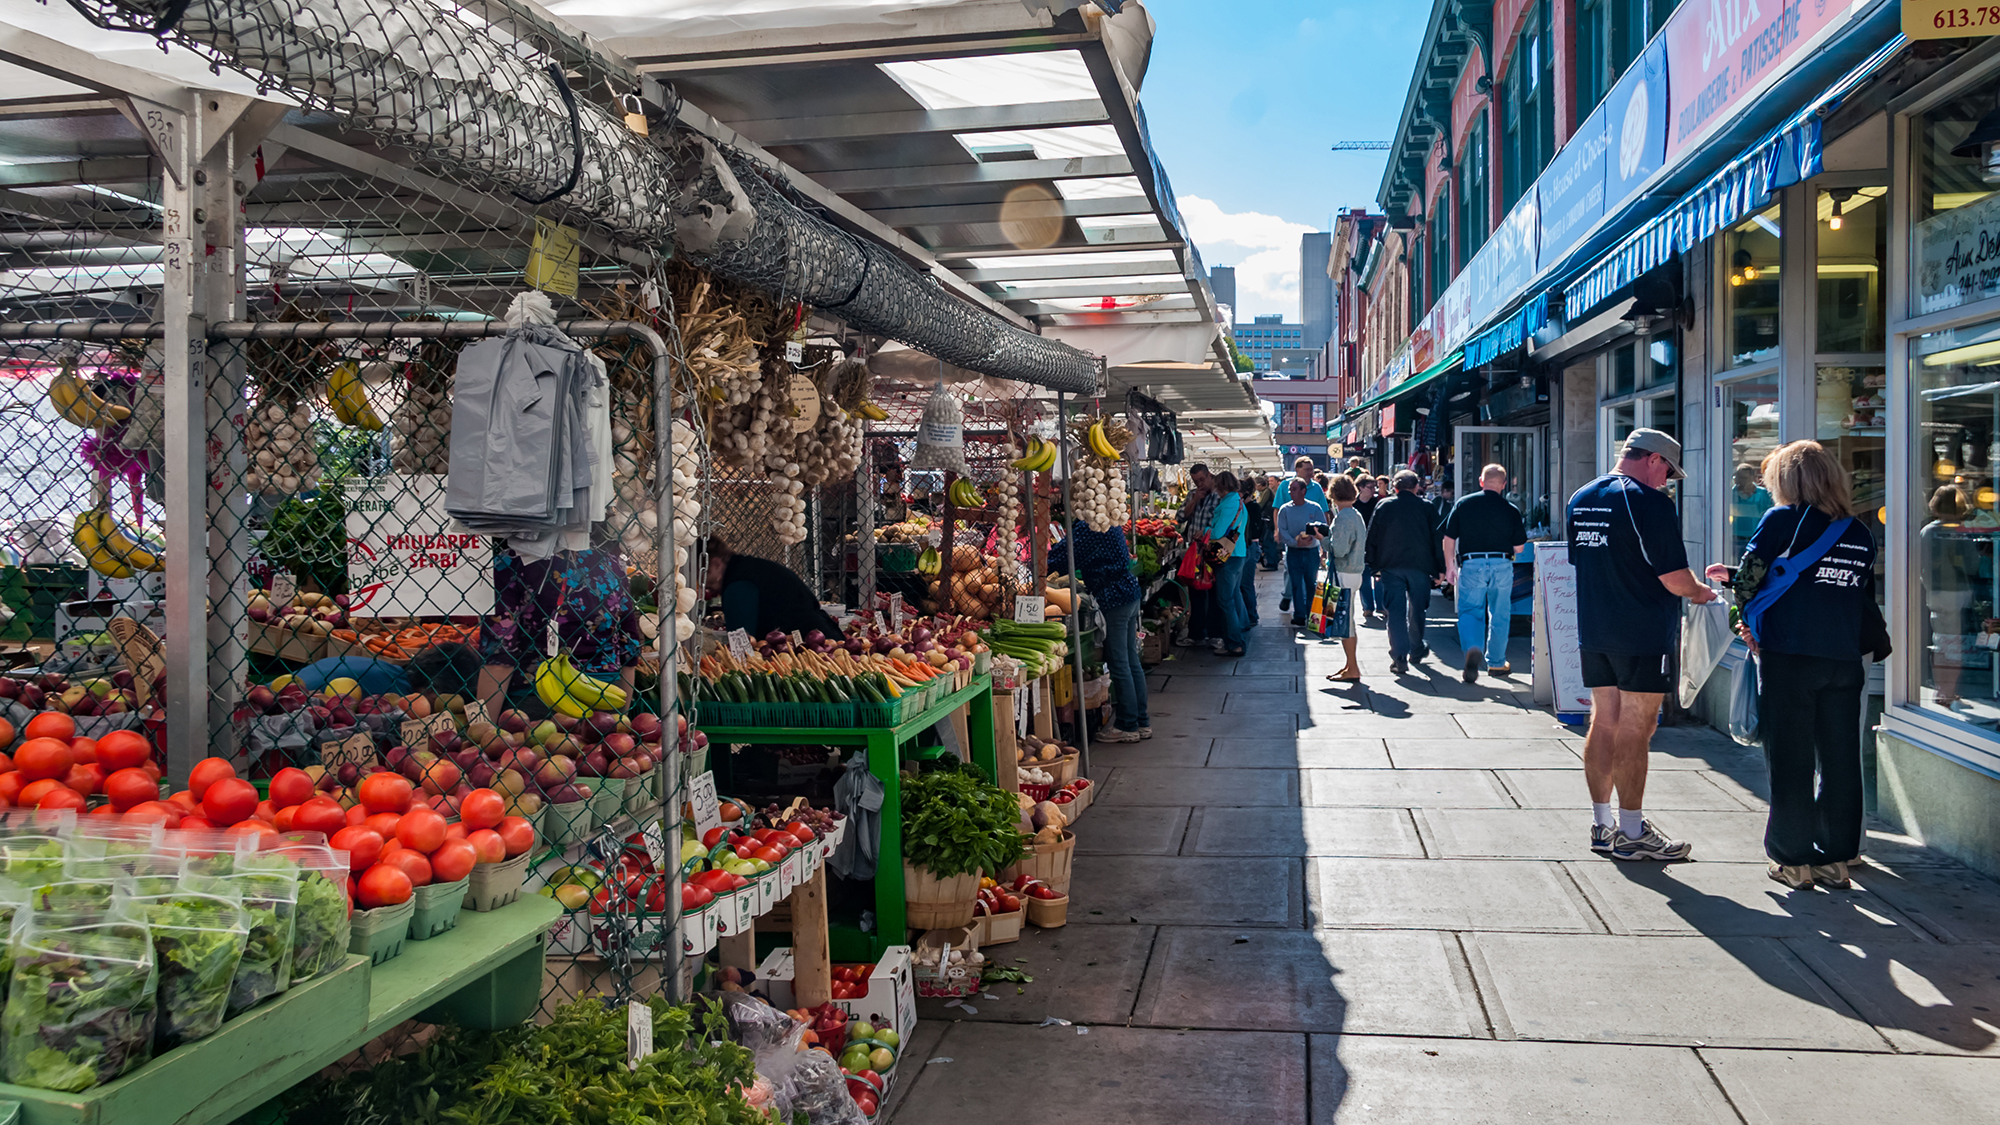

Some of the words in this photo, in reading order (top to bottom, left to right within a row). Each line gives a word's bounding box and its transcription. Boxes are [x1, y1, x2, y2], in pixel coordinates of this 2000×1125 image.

[1933, 6, 2000, 29] 613.78
[1678, 66, 1730, 145] BOULANGERIE
[1732, 75, 1736, 95] &
[1740, 2, 1801, 88] PATISSERIE
[147, 110, 165, 131] 53
[1553, 166, 1574, 205] House
[1581, 122, 1614, 172] Cheese
[1586, 180, 1604, 213] CHEESE
[168, 242, 180, 255] 53
[1946, 240, 1974, 277] Aux
[189, 339, 204, 355] 53
[387, 534, 480, 550] RHUBARBE
[1575, 531, 1600, 541] ARMY
[409, 553, 458, 569] SERBI
[1546, 571, 1573, 584] Home
[1815, 566, 1854, 581] ARMY
